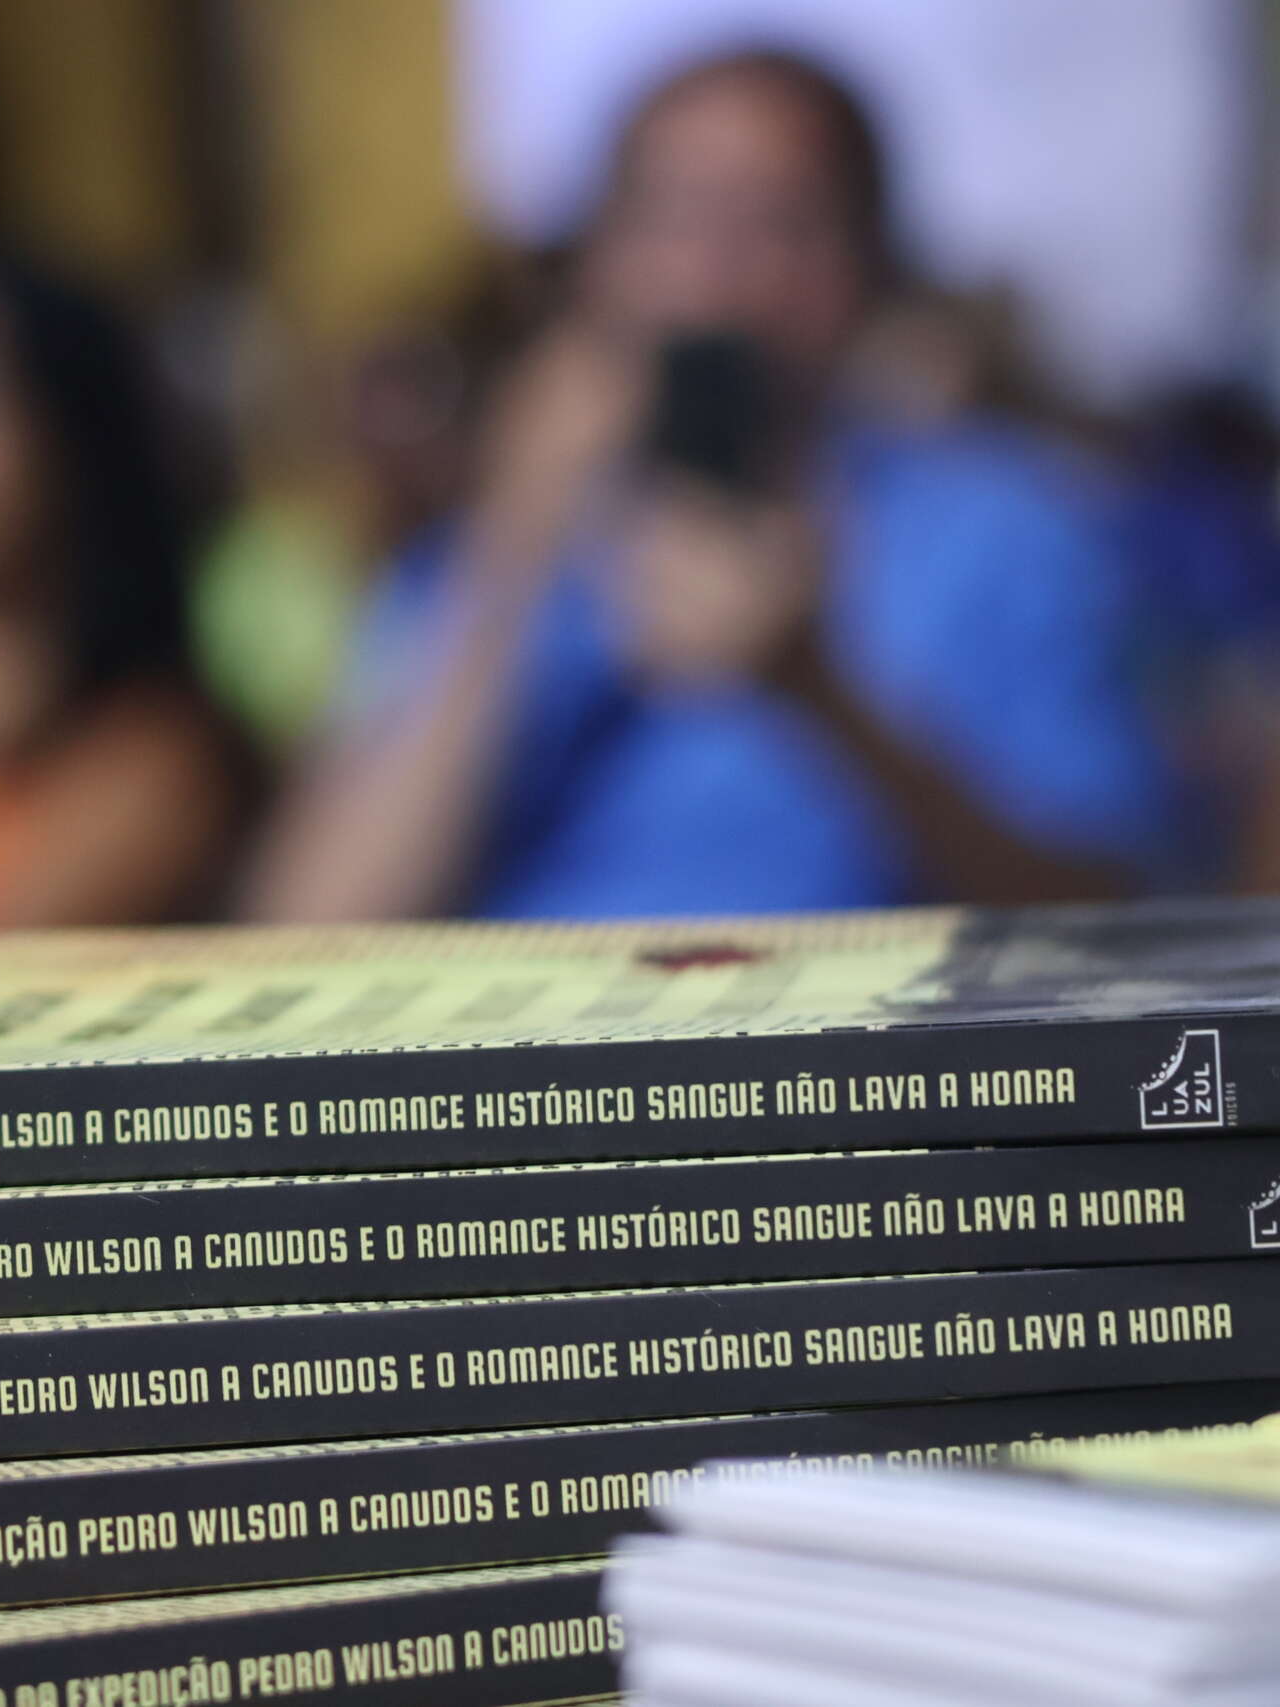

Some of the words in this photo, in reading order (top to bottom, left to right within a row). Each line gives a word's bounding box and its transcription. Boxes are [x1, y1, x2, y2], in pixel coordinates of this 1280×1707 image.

[84, 1109, 104, 1145] A
[114, 1103, 254, 1144] CANUDOS
[263, 1102, 279, 1137] E
[289, 1100, 308, 1137] O
[318, 1094, 465, 1135] ROMANCE
[475, 1082, 635, 1129] HISTÓRICO
[647, 1081, 765, 1121] SANGUE
[775, 1071, 837, 1116] NÃO
[848, 1074, 927, 1113] LAVA
[939, 1072, 959, 1109] A
[970, 1067, 1076, 1107] HONRA
[43, 1236, 162, 1277] WILSON
[174, 1235, 193, 1271] A
[204, 1227, 348, 1269] CANUDOS
[359, 1226, 375, 1262] E
[385, 1224, 405, 1261] O
[416, 1217, 567, 1259] ROMANCE
[577, 1204, 741, 1251] HISTÓRICO
[752, 1202, 873, 1243] SANGUE
[883, 1192, 945, 1237] NÃO
[956, 1194, 1036, 1233] LAVA
[1048, 1192, 1068, 1229] A
[1079, 1187, 1185, 1227] HONRA
[87, 1367, 209, 1410] WILSON
[221, 1365, 241, 1402] A
[251, 1355, 399, 1400] CANUDOS
[409, 1353, 426, 1390] E
[436, 1351, 456, 1389] O
[466, 1341, 619, 1387] ROMANCE
[628, 1327, 793, 1376] HISTÓRICO
[804, 1322, 925, 1365] SANGUE
[934, 1312, 996, 1357] NÃO
[1007, 1312, 1086, 1353] LAVA
[1097, 1310, 1118, 1347] A
[1128, 1303, 1233, 1345] HONRA
[78, 1511, 178, 1556] PEDRO
[187, 1500, 309, 1547] WILSON
[319, 1498, 339, 1536] A
[349, 1484, 494, 1533] CANUDOS
[504, 1482, 521, 1520] E
[530, 1480, 550, 1518] O
[239, 1648, 334, 1697] PEDRO
[341, 1633, 455, 1685] WILSON
[463, 1630, 483, 1669] A
[491, 1613, 626, 1668] CANUDOS
